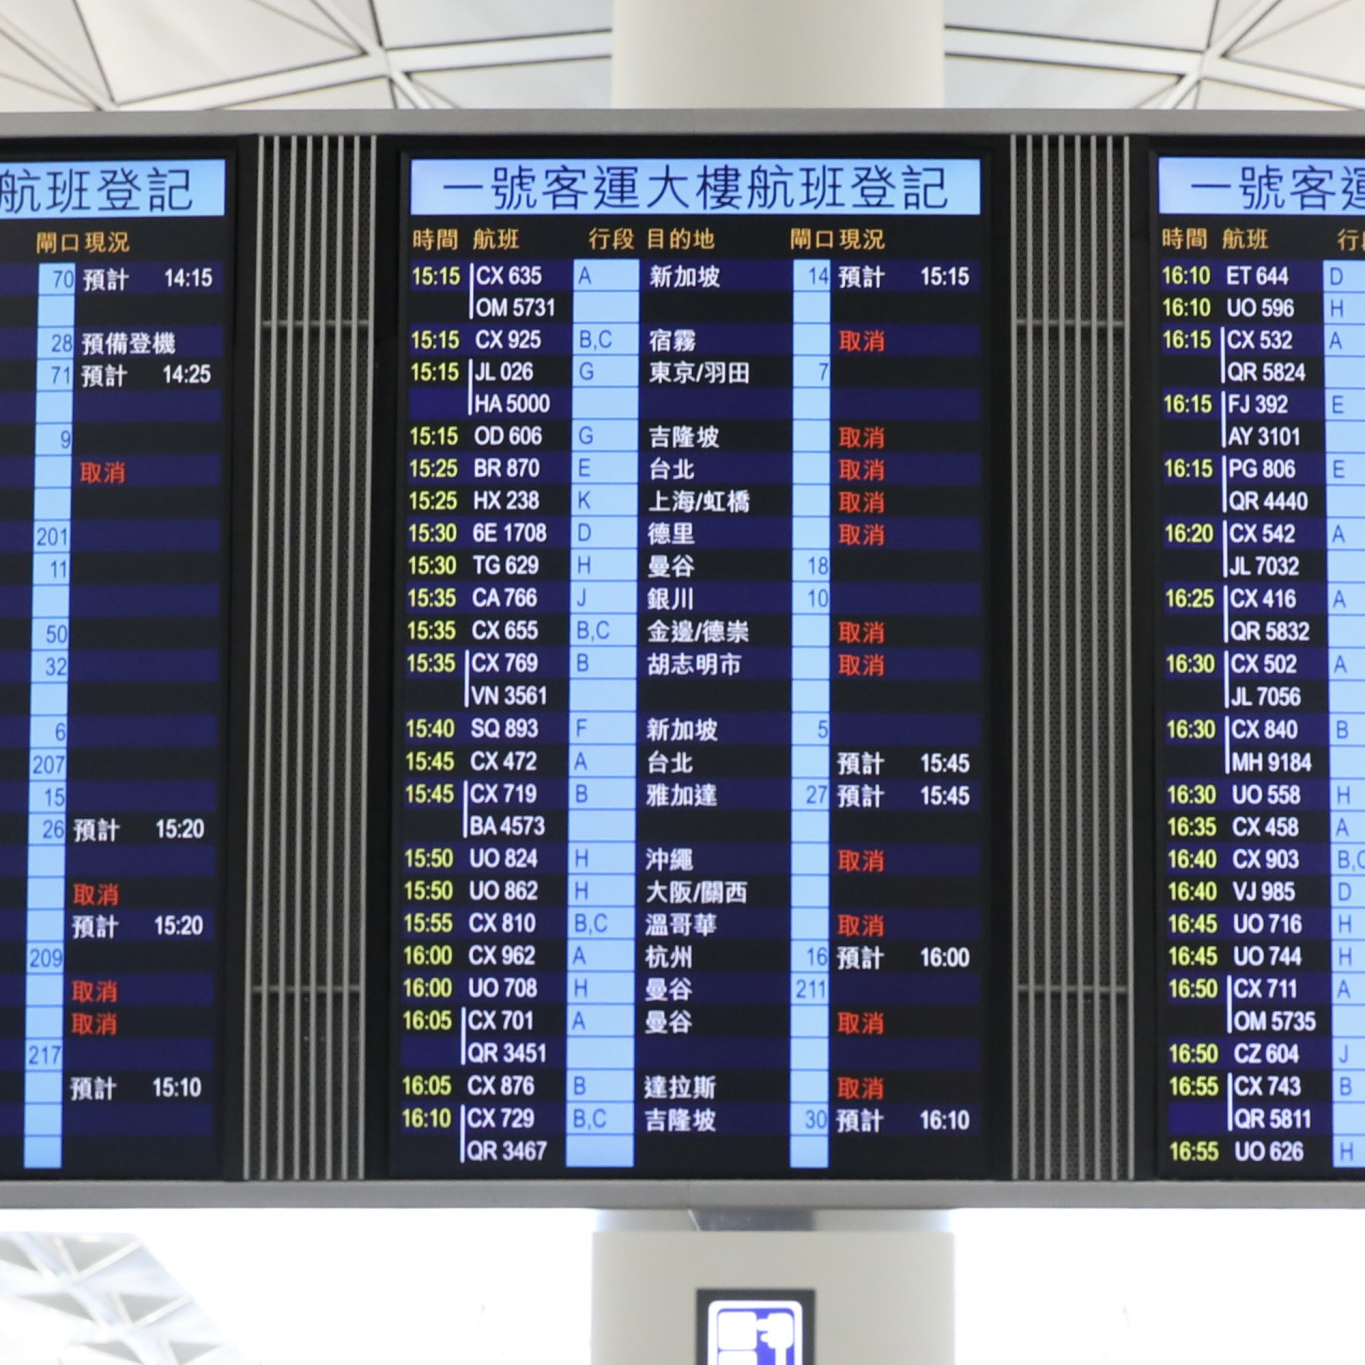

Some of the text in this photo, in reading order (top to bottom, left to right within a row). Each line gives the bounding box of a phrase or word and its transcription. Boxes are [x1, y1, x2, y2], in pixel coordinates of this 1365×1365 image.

[443, 163, 948, 211] 一號客運大樓航班登記
[84, 231, 130, 253] 現況
[412, 227, 458, 251] 時間
[472, 227, 520, 250] 航班
[588, 227, 635, 250] 行段
[647, 227, 715, 250] 目的地
[839, 228, 886, 251] 現況
[1162, 226, 1208, 250] 時間
[1222, 227, 1269, 250] 航班
[53, 269, 75, 289] 70
[82, 267, 130, 292] 預計
[164, 267, 213, 287] 14:15
[412, 264, 970, 289] 15:15 CX 635 A 新加坡 14 預計 15:15
[1162, 297, 1211, 317] 16:10
[1227, 297, 1257, 318] UO
[1261, 298, 1295, 318] 596
[1330, 299, 1344, 318] H
[409, 456, 885, 481] 15:25 BR 870 E 台北 取消
[36, 526, 67, 547] 201
[1165, 523, 1214, 543] 16:20
[1229, 522, 1258, 543] CX
[1262, 523, 1296, 544] 542
[1331, 524, 1346, 543] A
[1169, 978, 1218, 999] 16:50
[1233, 977, 1263, 999] CX
[1266, 978, 1297, 999] 711
[1337, 979, 1351, 998] A
[71, 1012, 117, 1036] 取消
[1233, 1010, 1317, 1032] OM 5735
[402, 1107, 970, 1133] 16:10 CX 729 B,C 吉隆坡 30 預計 16:10
